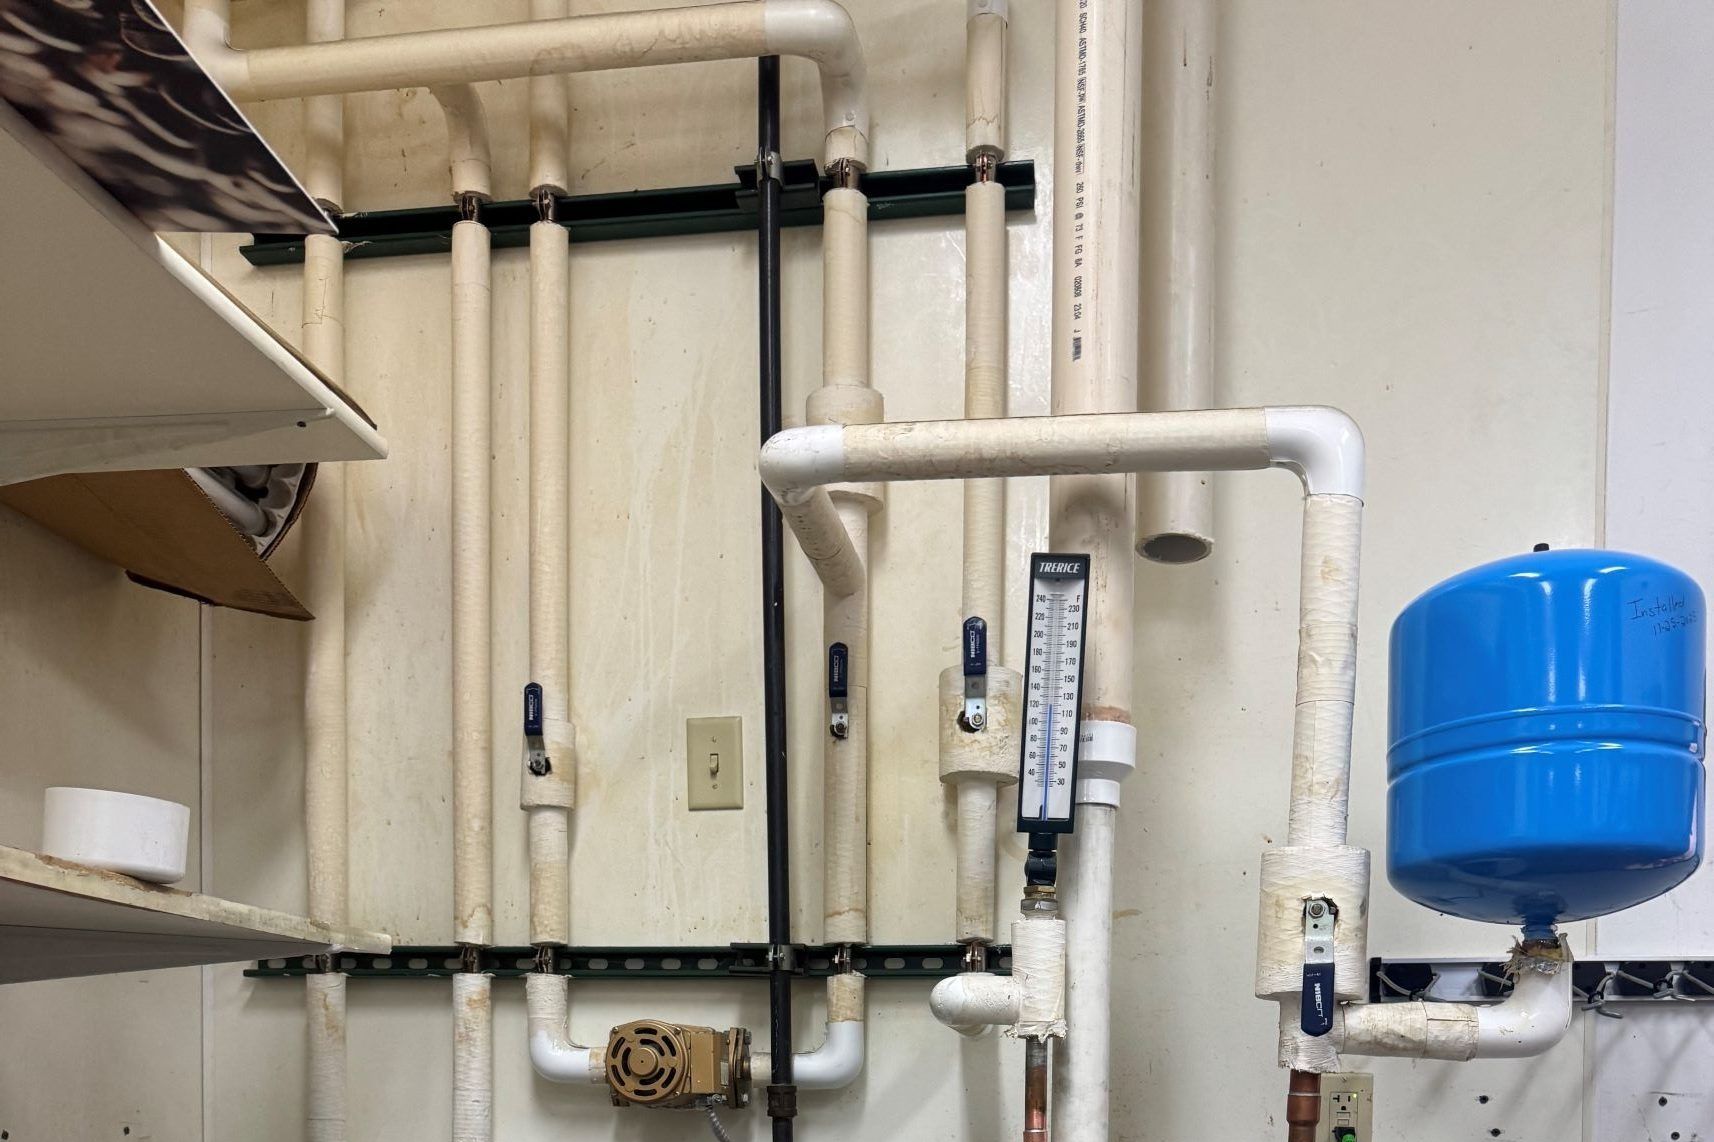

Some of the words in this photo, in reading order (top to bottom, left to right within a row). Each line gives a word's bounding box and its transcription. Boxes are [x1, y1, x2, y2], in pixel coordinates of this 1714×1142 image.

[1075, 197, 1084, 208] PSI
[1040, 562, 1080, 573] TRERICE
[1036, 595, 1046, 603] 240
[1068, 605, 1080, 613] 230
[1627, 594, 1685, 620] Installed
[1067, 622, 1079, 630] 210
[1034, 630, 1043, 638] 200
[1066, 640, 1077, 648] 190
[1033, 648, 1042, 656] 180
[1064, 675, 1075, 683] 150
[1063, 692, 1073, 700] 130
[1029, 700, 1039, 708] 120
[1060, 727, 1068, 735] 90
[1030, 734, 1037, 742] 80
[1060, 744, 1067, 752] 70
[1029, 751, 1036, 759] 60
